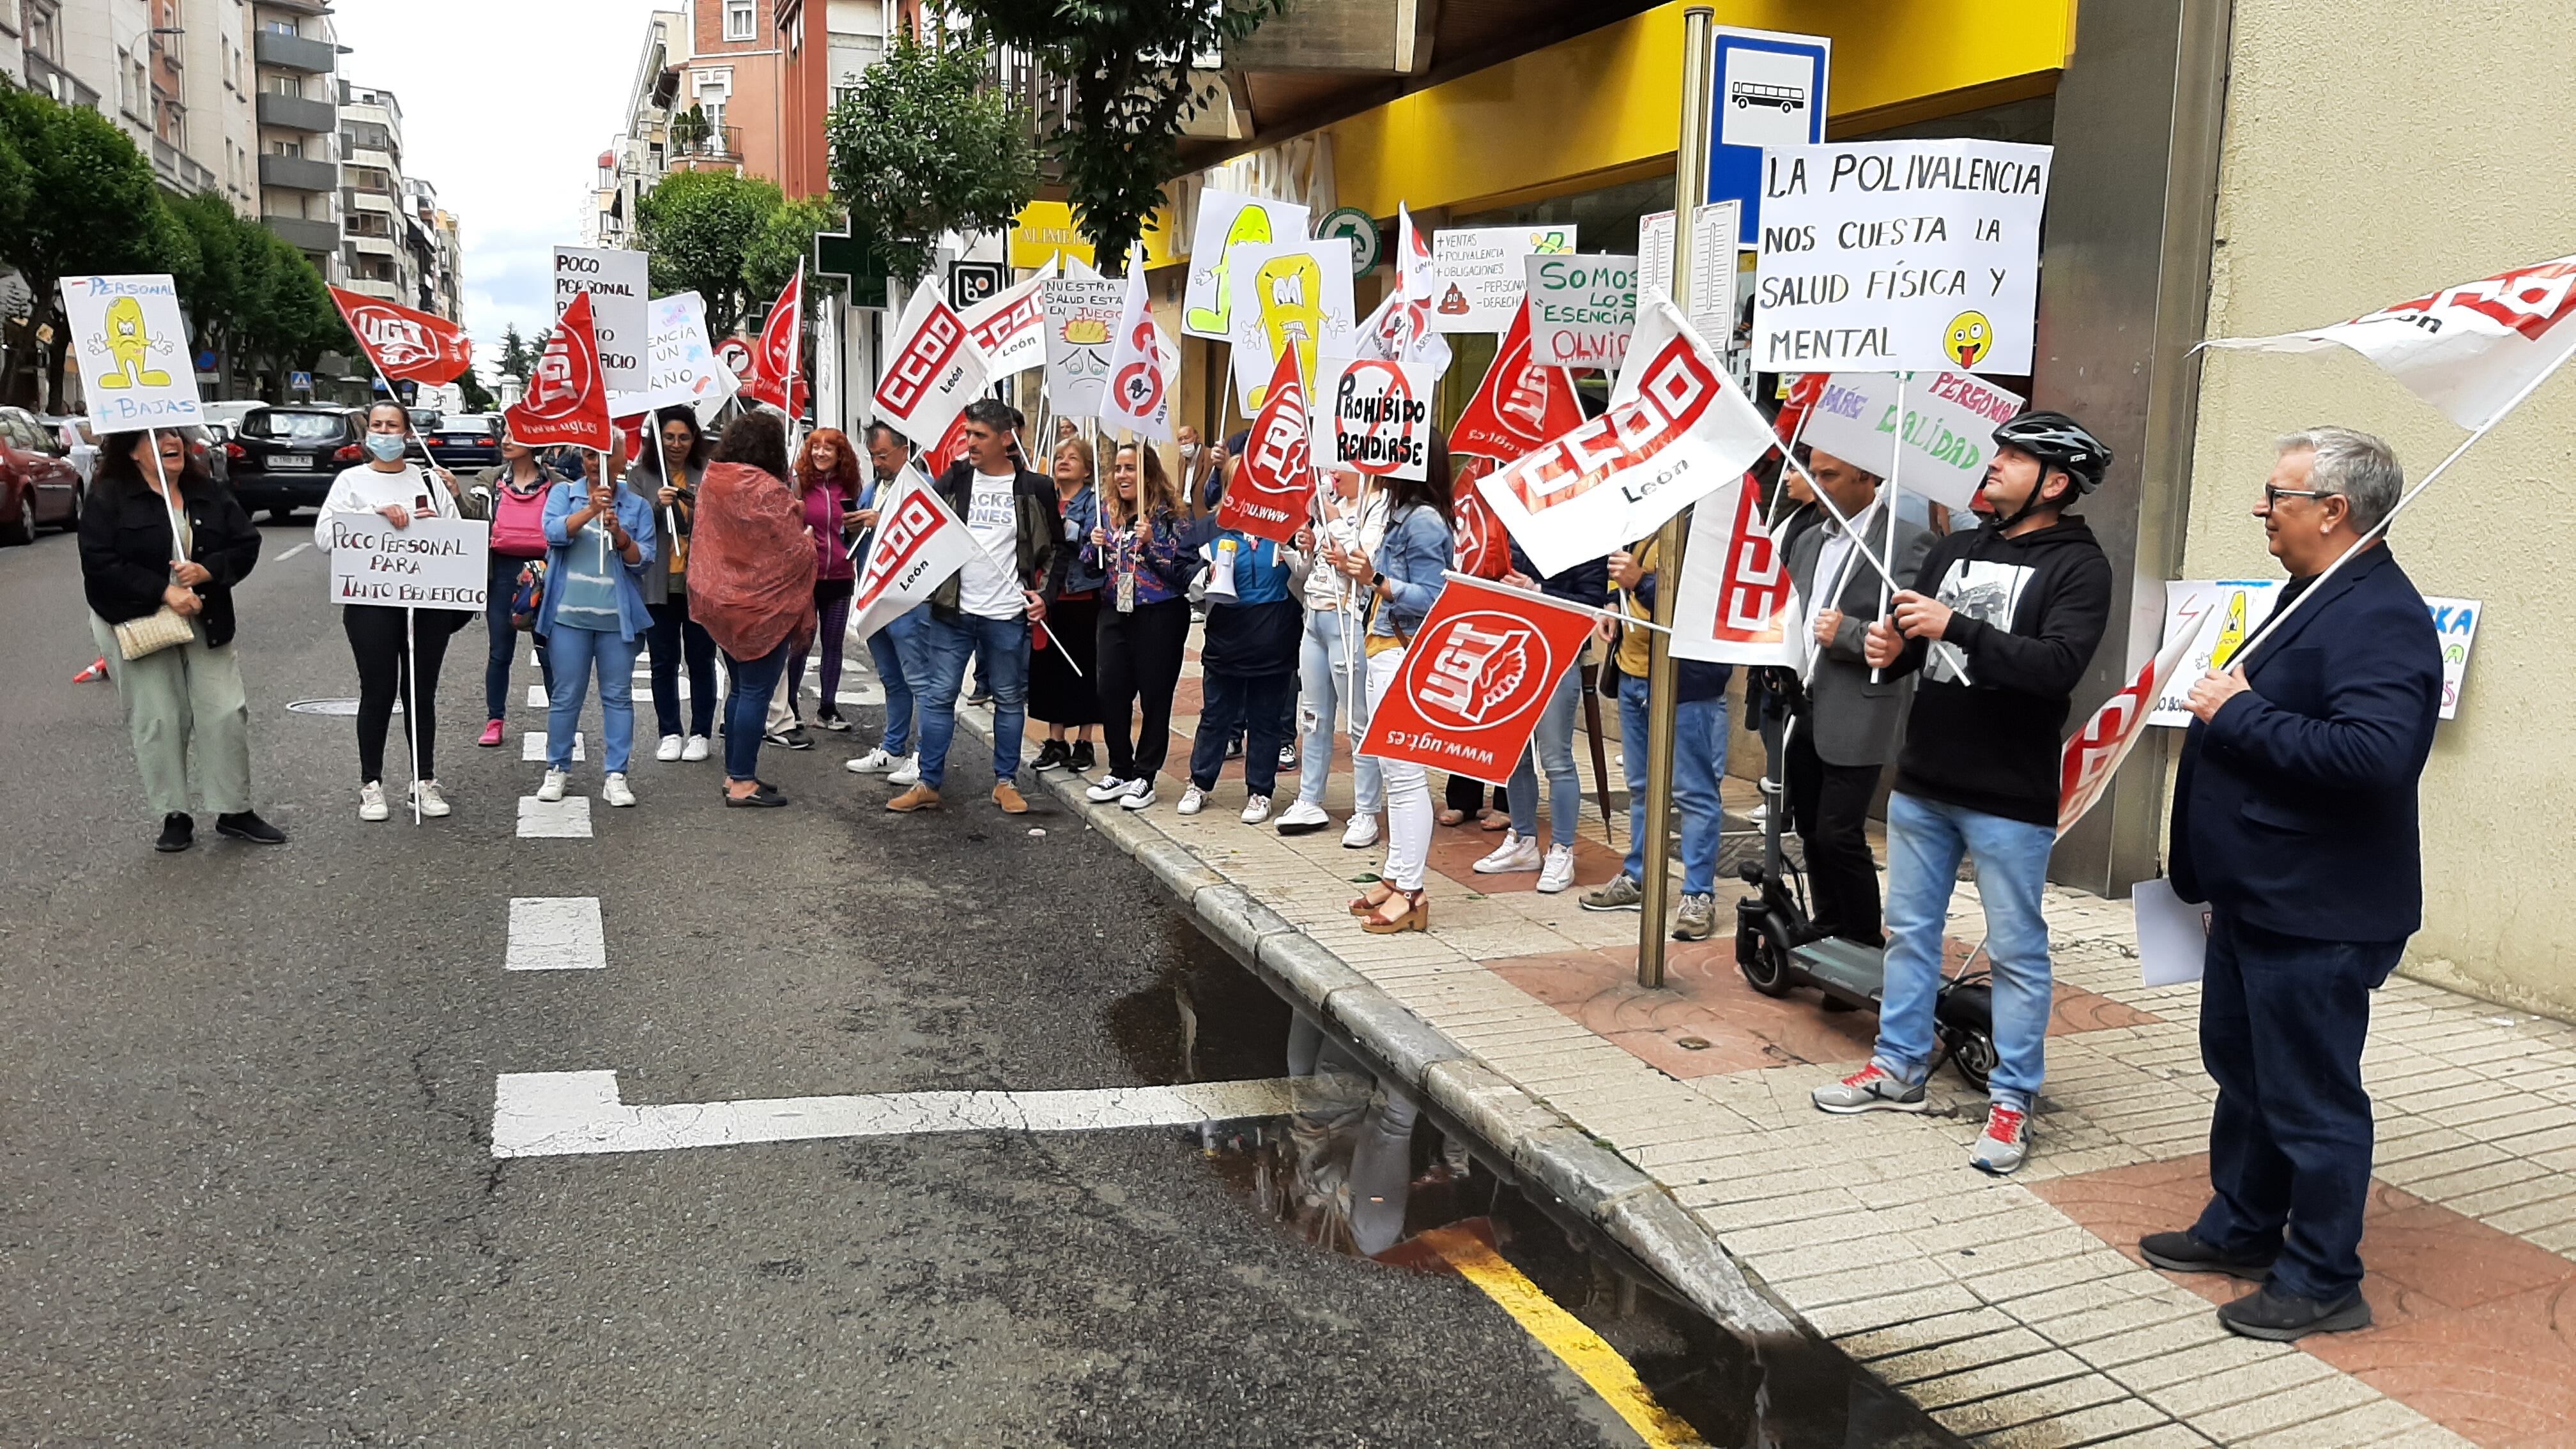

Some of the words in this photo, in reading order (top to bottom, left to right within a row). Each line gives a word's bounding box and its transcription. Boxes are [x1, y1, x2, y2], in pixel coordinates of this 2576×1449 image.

[1767, 155, 1807, 199] LA
[1829, 153, 2042, 195] POLIVALENCIA
[1764, 224, 1816, 255] NOS
[1837, 216, 1947, 249] CUESTA
[1975, 218, 2001, 242] LA
[556, 255, 600, 273] POCO
[1045, 293, 1085, 304] SALUD
[1089, 295, 1123, 305] ESTA
[1046, 282, 1116, 292] NUESTRA
[1590, 292, 1637, 308] LOS
[1759, 274, 1850, 309] SALUD
[1867, 260, 1966, 299] FÍSICA
[1989, 268, 2006, 297] Y
[1049, 307, 1066, 316] EN
[359, 312, 424, 346] UGT
[1769, 326, 1897, 363] MENTAL
[656, 345, 680, 362] UN
[1002, 336, 1037, 356] León
[939, 366, 965, 394] León
[116, 397, 196, 418] BAJAS
[1519, 355, 1704, 497] CCOO
[1621, 457, 1689, 503] León
[332, 522, 376, 549] POCO
[381, 532, 468, 556] PERSONAL
[370, 554, 422, 574] PARA
[899, 560, 930, 592] León
[339, 574, 394, 599] TANTO
[399, 583, 487, 604] BENEFICIO
[1419, 622, 1509, 712] UGT
[1386, 730, 1494, 766] www.ugt.es
